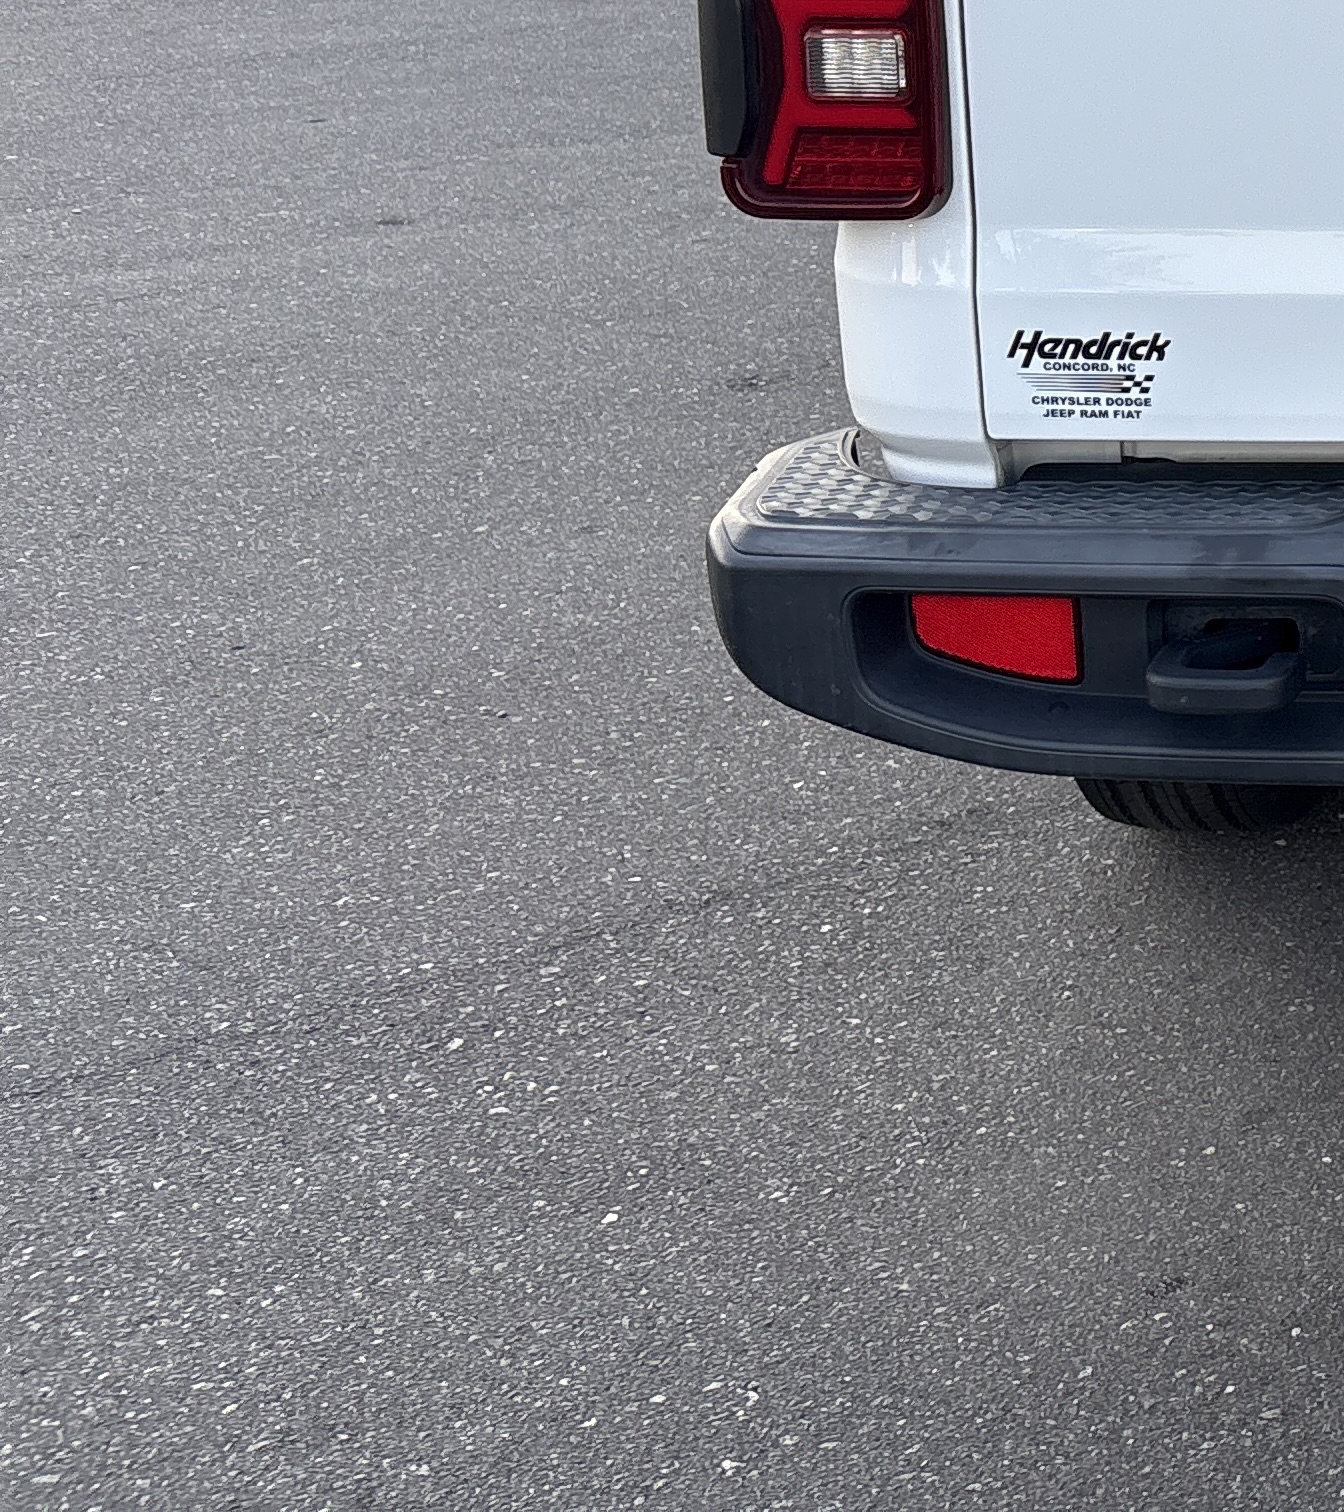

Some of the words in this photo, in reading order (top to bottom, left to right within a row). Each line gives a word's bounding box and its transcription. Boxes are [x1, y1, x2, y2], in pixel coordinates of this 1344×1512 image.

[1007, 330, 1171, 368] Hendrick
[1043, 362, 1113, 373] CONCORD,
[1117, 363, 1136, 372] NC
[1031, 396, 1101, 406] CHRYSLER
[1105, 397, 1152, 407] DODGE
[1042, 409, 1076, 418] JEEP
[1079, 410, 1109, 419] RAM
[1113, 410, 1142, 419] FIAT
